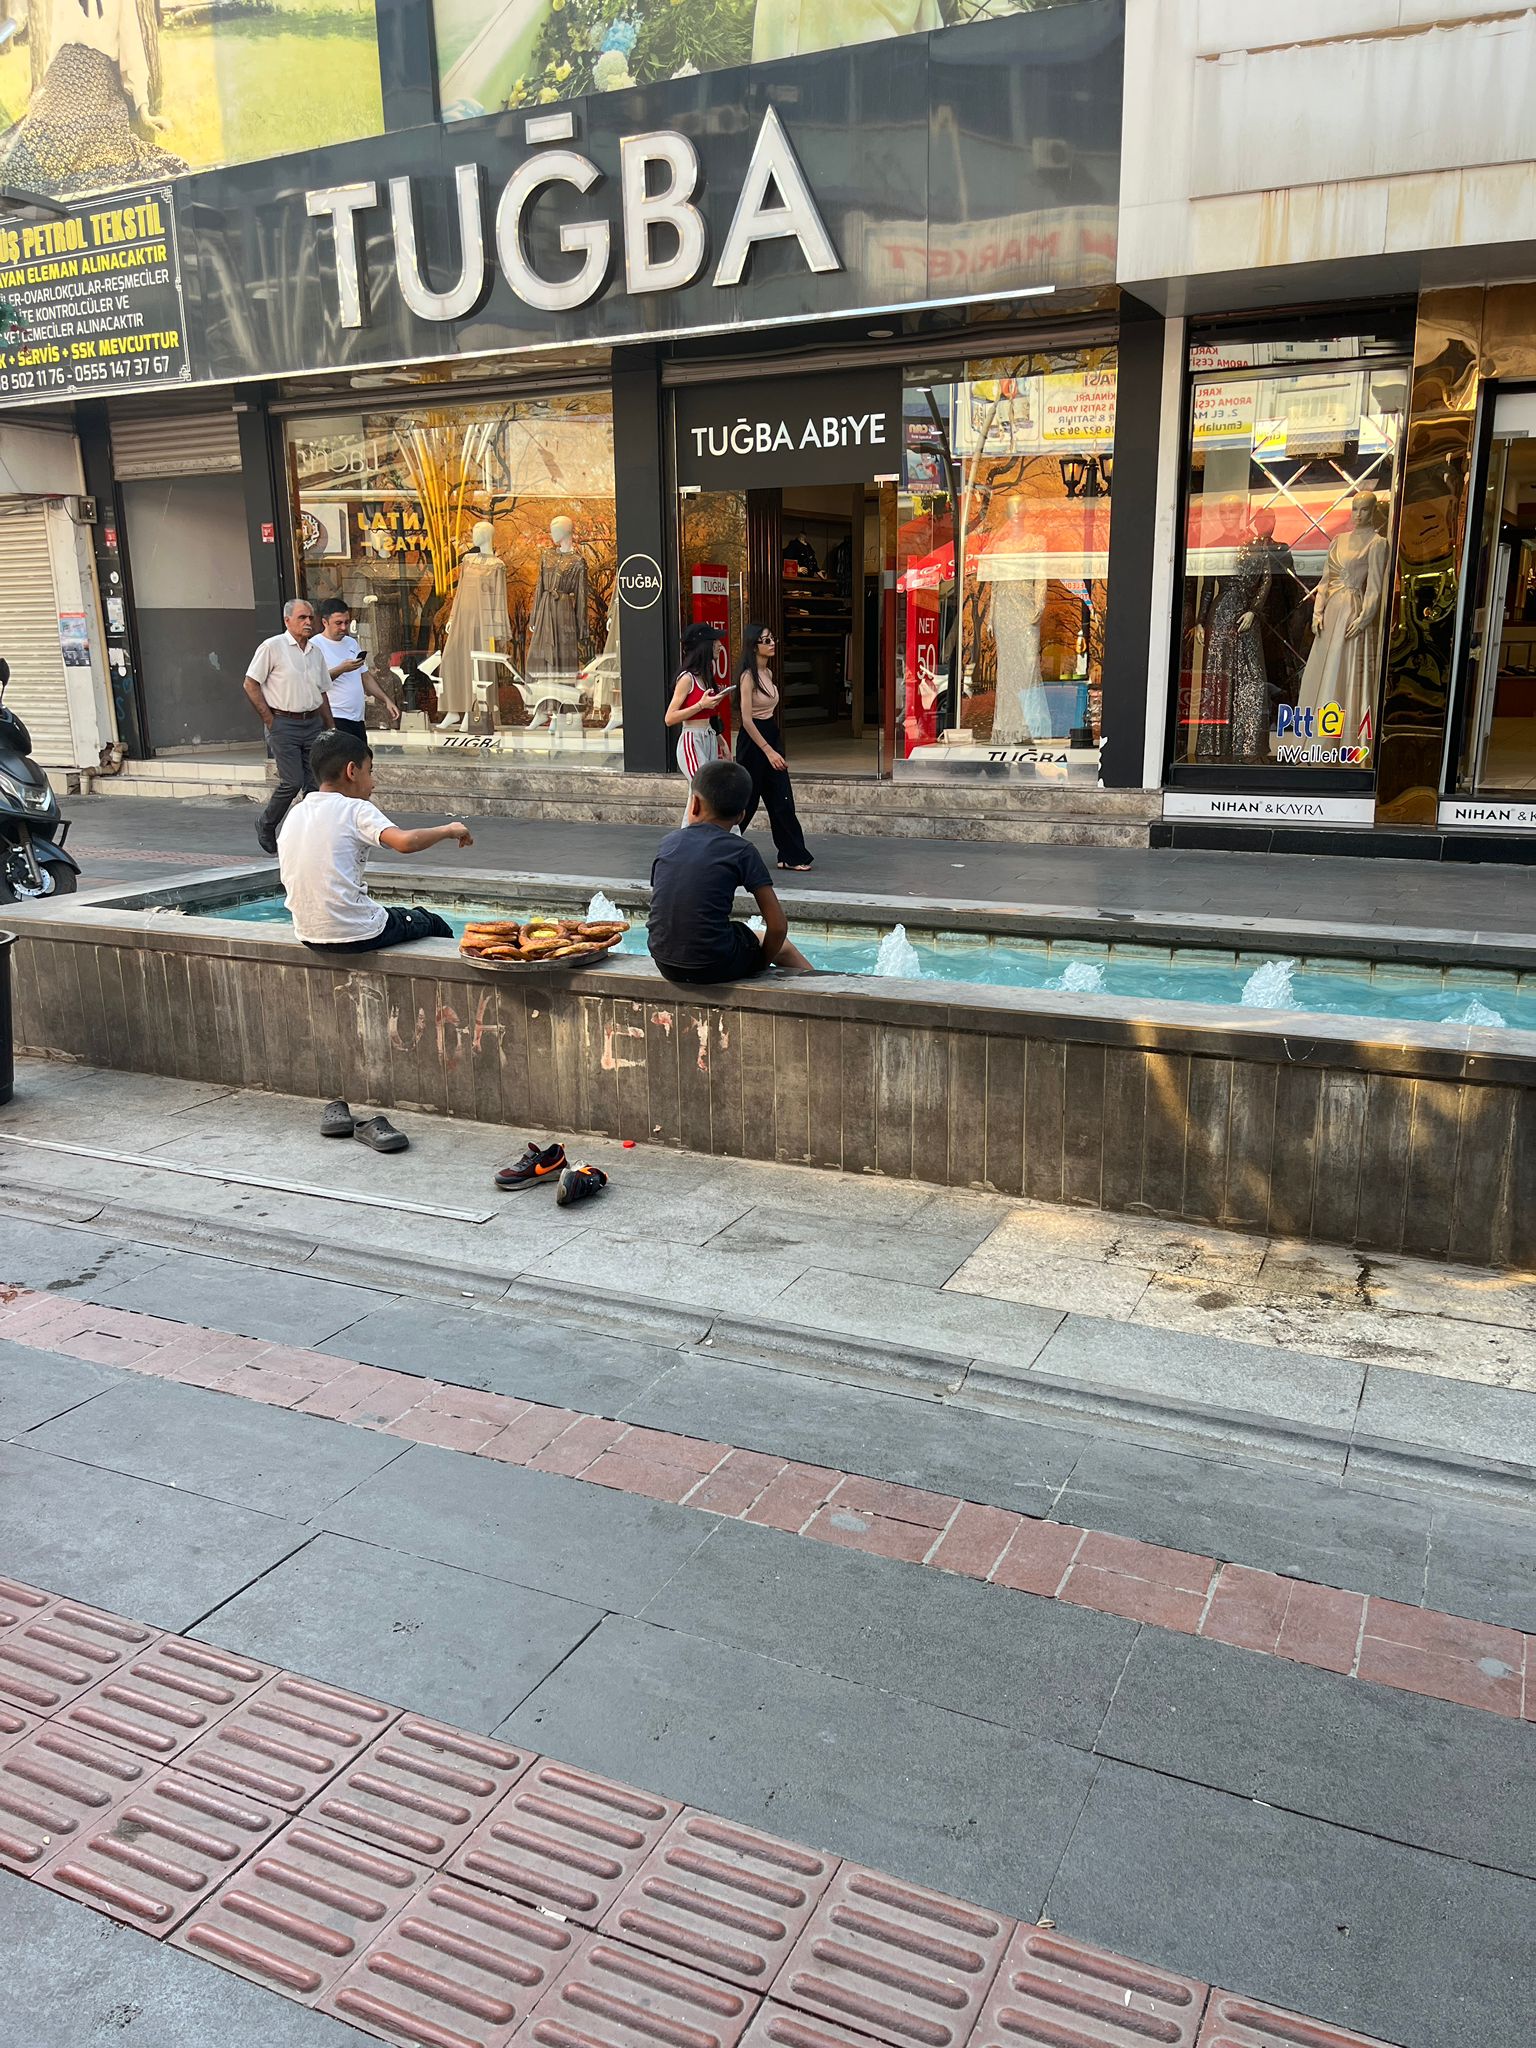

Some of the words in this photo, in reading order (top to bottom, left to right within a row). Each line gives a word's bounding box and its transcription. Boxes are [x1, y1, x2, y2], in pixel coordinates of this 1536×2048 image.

[22, 218, 88, 259] PETROL
[90, 197, 165, 246] TEKSTİL
[306, 103, 841, 328] TUĞBA
[27, 260, 79, 284] ELEMAN
[81, 244, 167, 275] ALINACAKTIR
[36, 297, 113, 322] KONTROLCÜLER
[115, 295, 130, 310] VE
[77, 312, 144, 336] ALINACAKTIR
[17, 343, 60, 367] SERVİS
[71, 341, 97, 360] SSK
[99, 330, 179, 357] MEVCUTTUR
[0, 374, 9, 391] 8
[11, 371, 35, 389] 502
[36, 370, 47, 386] 11
[48, 368, 65, 384] 76
[74, 362, 107, 382] 0555
[109, 360, 131, 379] 147
[134, 358, 150, 375] 37
[153, 355, 169, 373] 67
[691, 418, 795, 457] TUĞBA
[620, 574, 660, 588] TUĞBA
[703, 578, 726, 592] TUĞBA
[918, 618, 935, 634] NET
[917, 643, 936, 680] 50
[1277, 745, 1338, 765] iWallet
[1211, 801, 1260, 813] NIHAN
[1265, 804, 1273, 813] &
[1276, 804, 1324, 816] KAYRA
[1455, 808, 1511, 820] NIHAN
[1517, 811, 1527, 821] &
